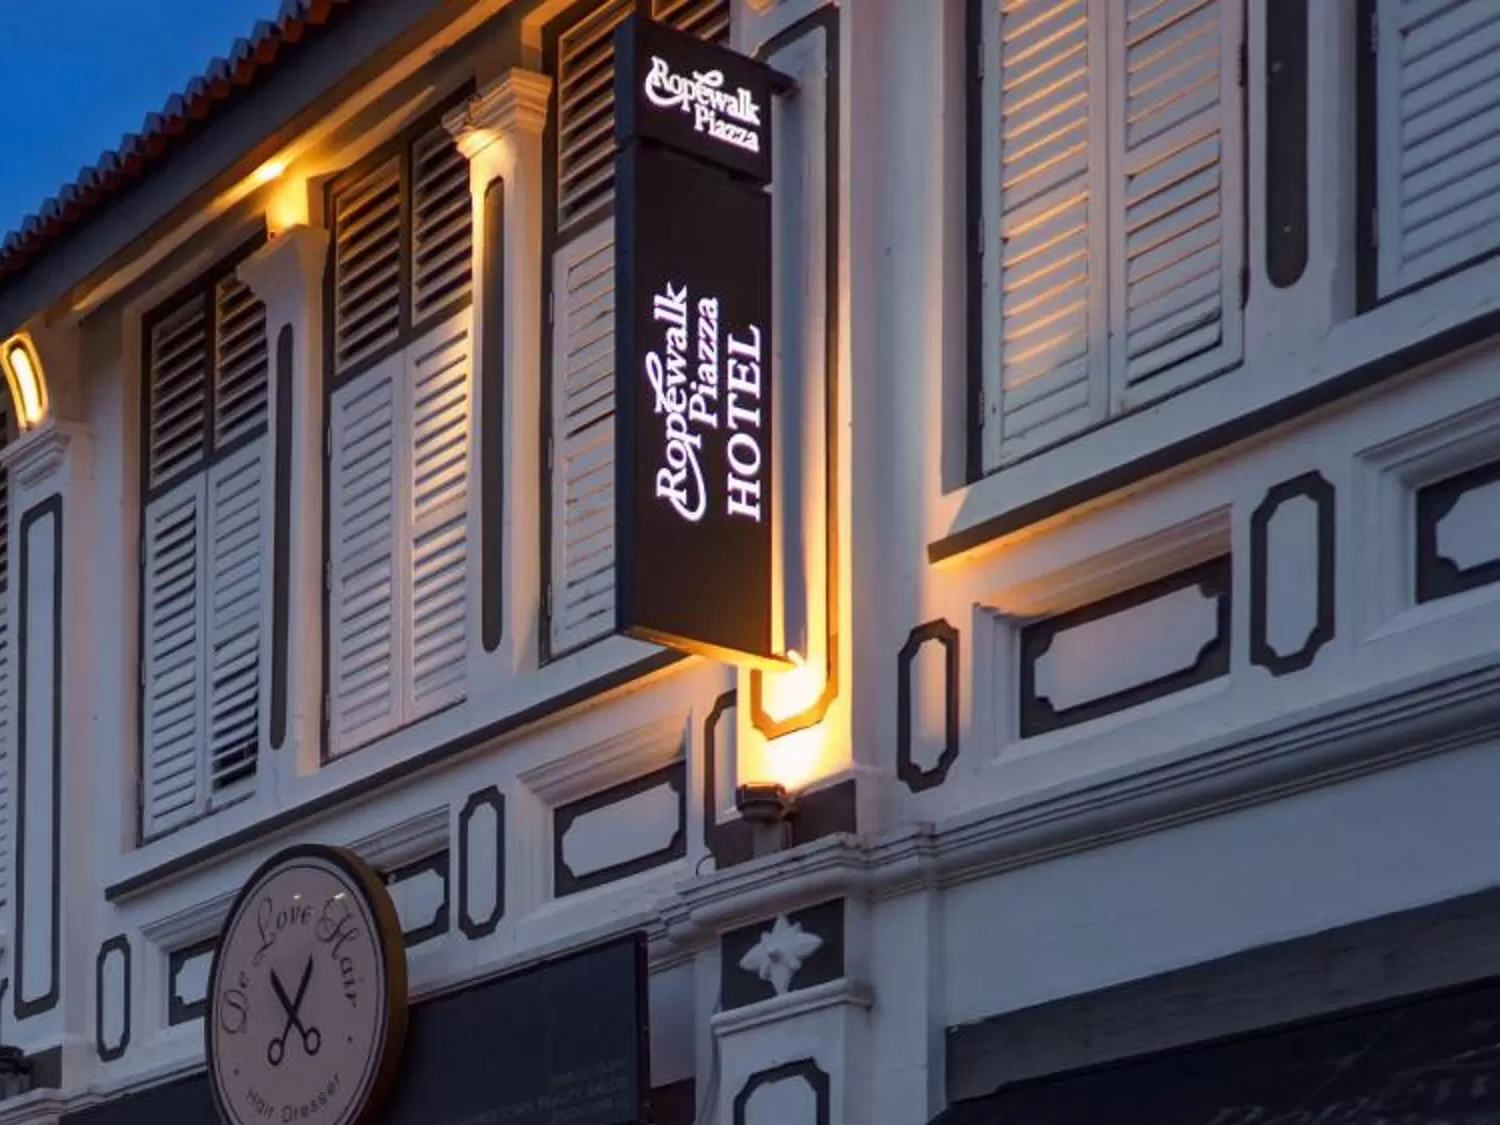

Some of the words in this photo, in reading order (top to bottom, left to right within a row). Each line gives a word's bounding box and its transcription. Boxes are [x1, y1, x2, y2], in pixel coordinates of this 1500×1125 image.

[645, 56, 760, 126] Ropewalk
[694, 104, 759, 153] Piazza
[646, 281, 706, 521] Ropewalk
[689, 297, 718, 429] Piazza
[727, 324, 761, 522] HOTEL
